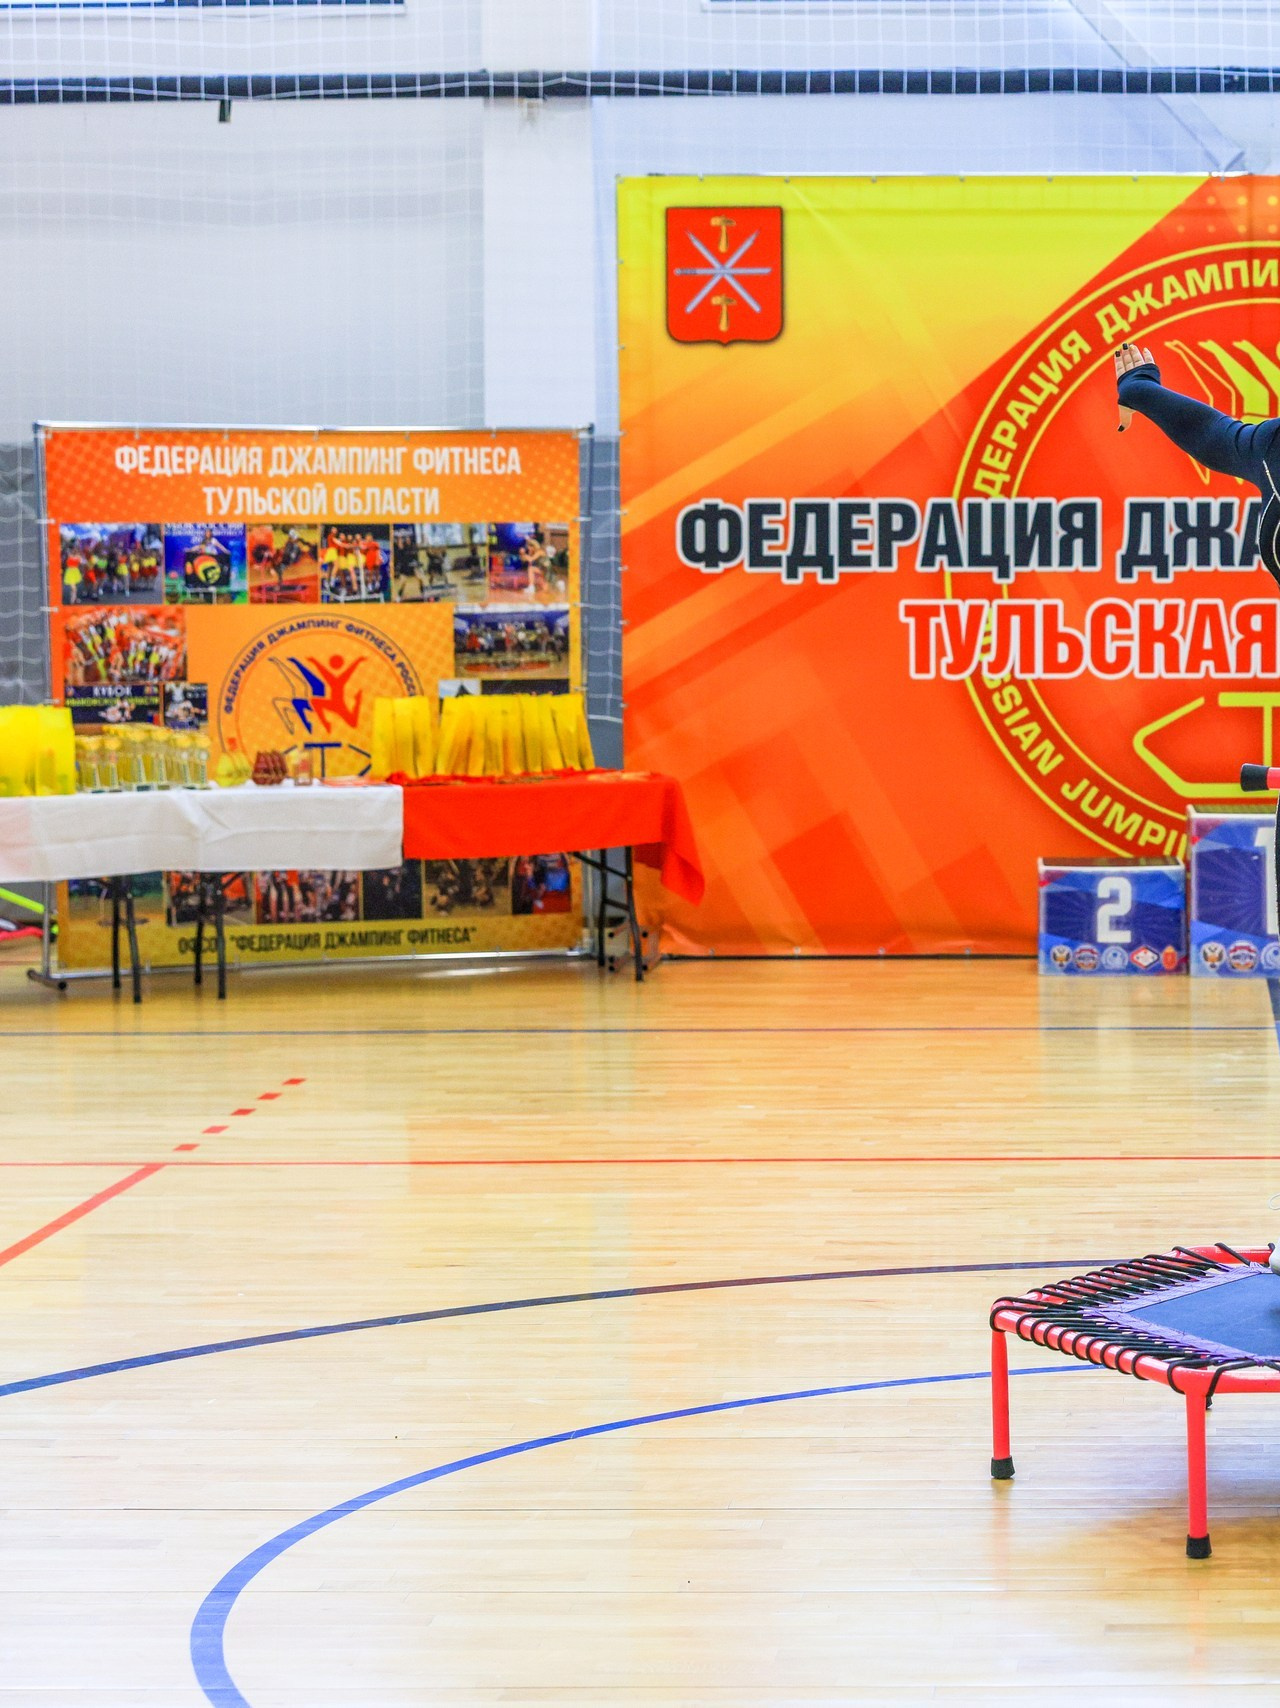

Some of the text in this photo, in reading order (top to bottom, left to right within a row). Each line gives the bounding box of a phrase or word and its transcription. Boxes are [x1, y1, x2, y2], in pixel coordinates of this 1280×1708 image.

[973, 329, 1092, 498] ДЕРАЦИЯ
[114, 445, 522, 478] ФЕДЕРАЦИЯ ДЖАМПИНГ ФИТНЕСА
[202, 482, 440, 516] ТУЛЬСКОЙ ОБЛАСТИ
[677, 499, 1101, 581] ФЕДЕРАЦИЯ
[224, 619, 417, 714] ФЕДЕРАЦИЯ ДЖАМПИНГ ФИТНЕСА РОСС
[902, 599, 1280, 679] ТУЛЬСКАЯ
[981, 628, 1187, 861] SSIAN JUMPI
[1097, 876, 1132, 943] 2
[1254, 826, 1278, 935] 1
[229, 934, 321, 952] "ФЕДЕРАЦИЯ
[324, 930, 404, 949] ДЖАМПИНГ
[407, 926, 478, 944] ФИТНЕСА"
